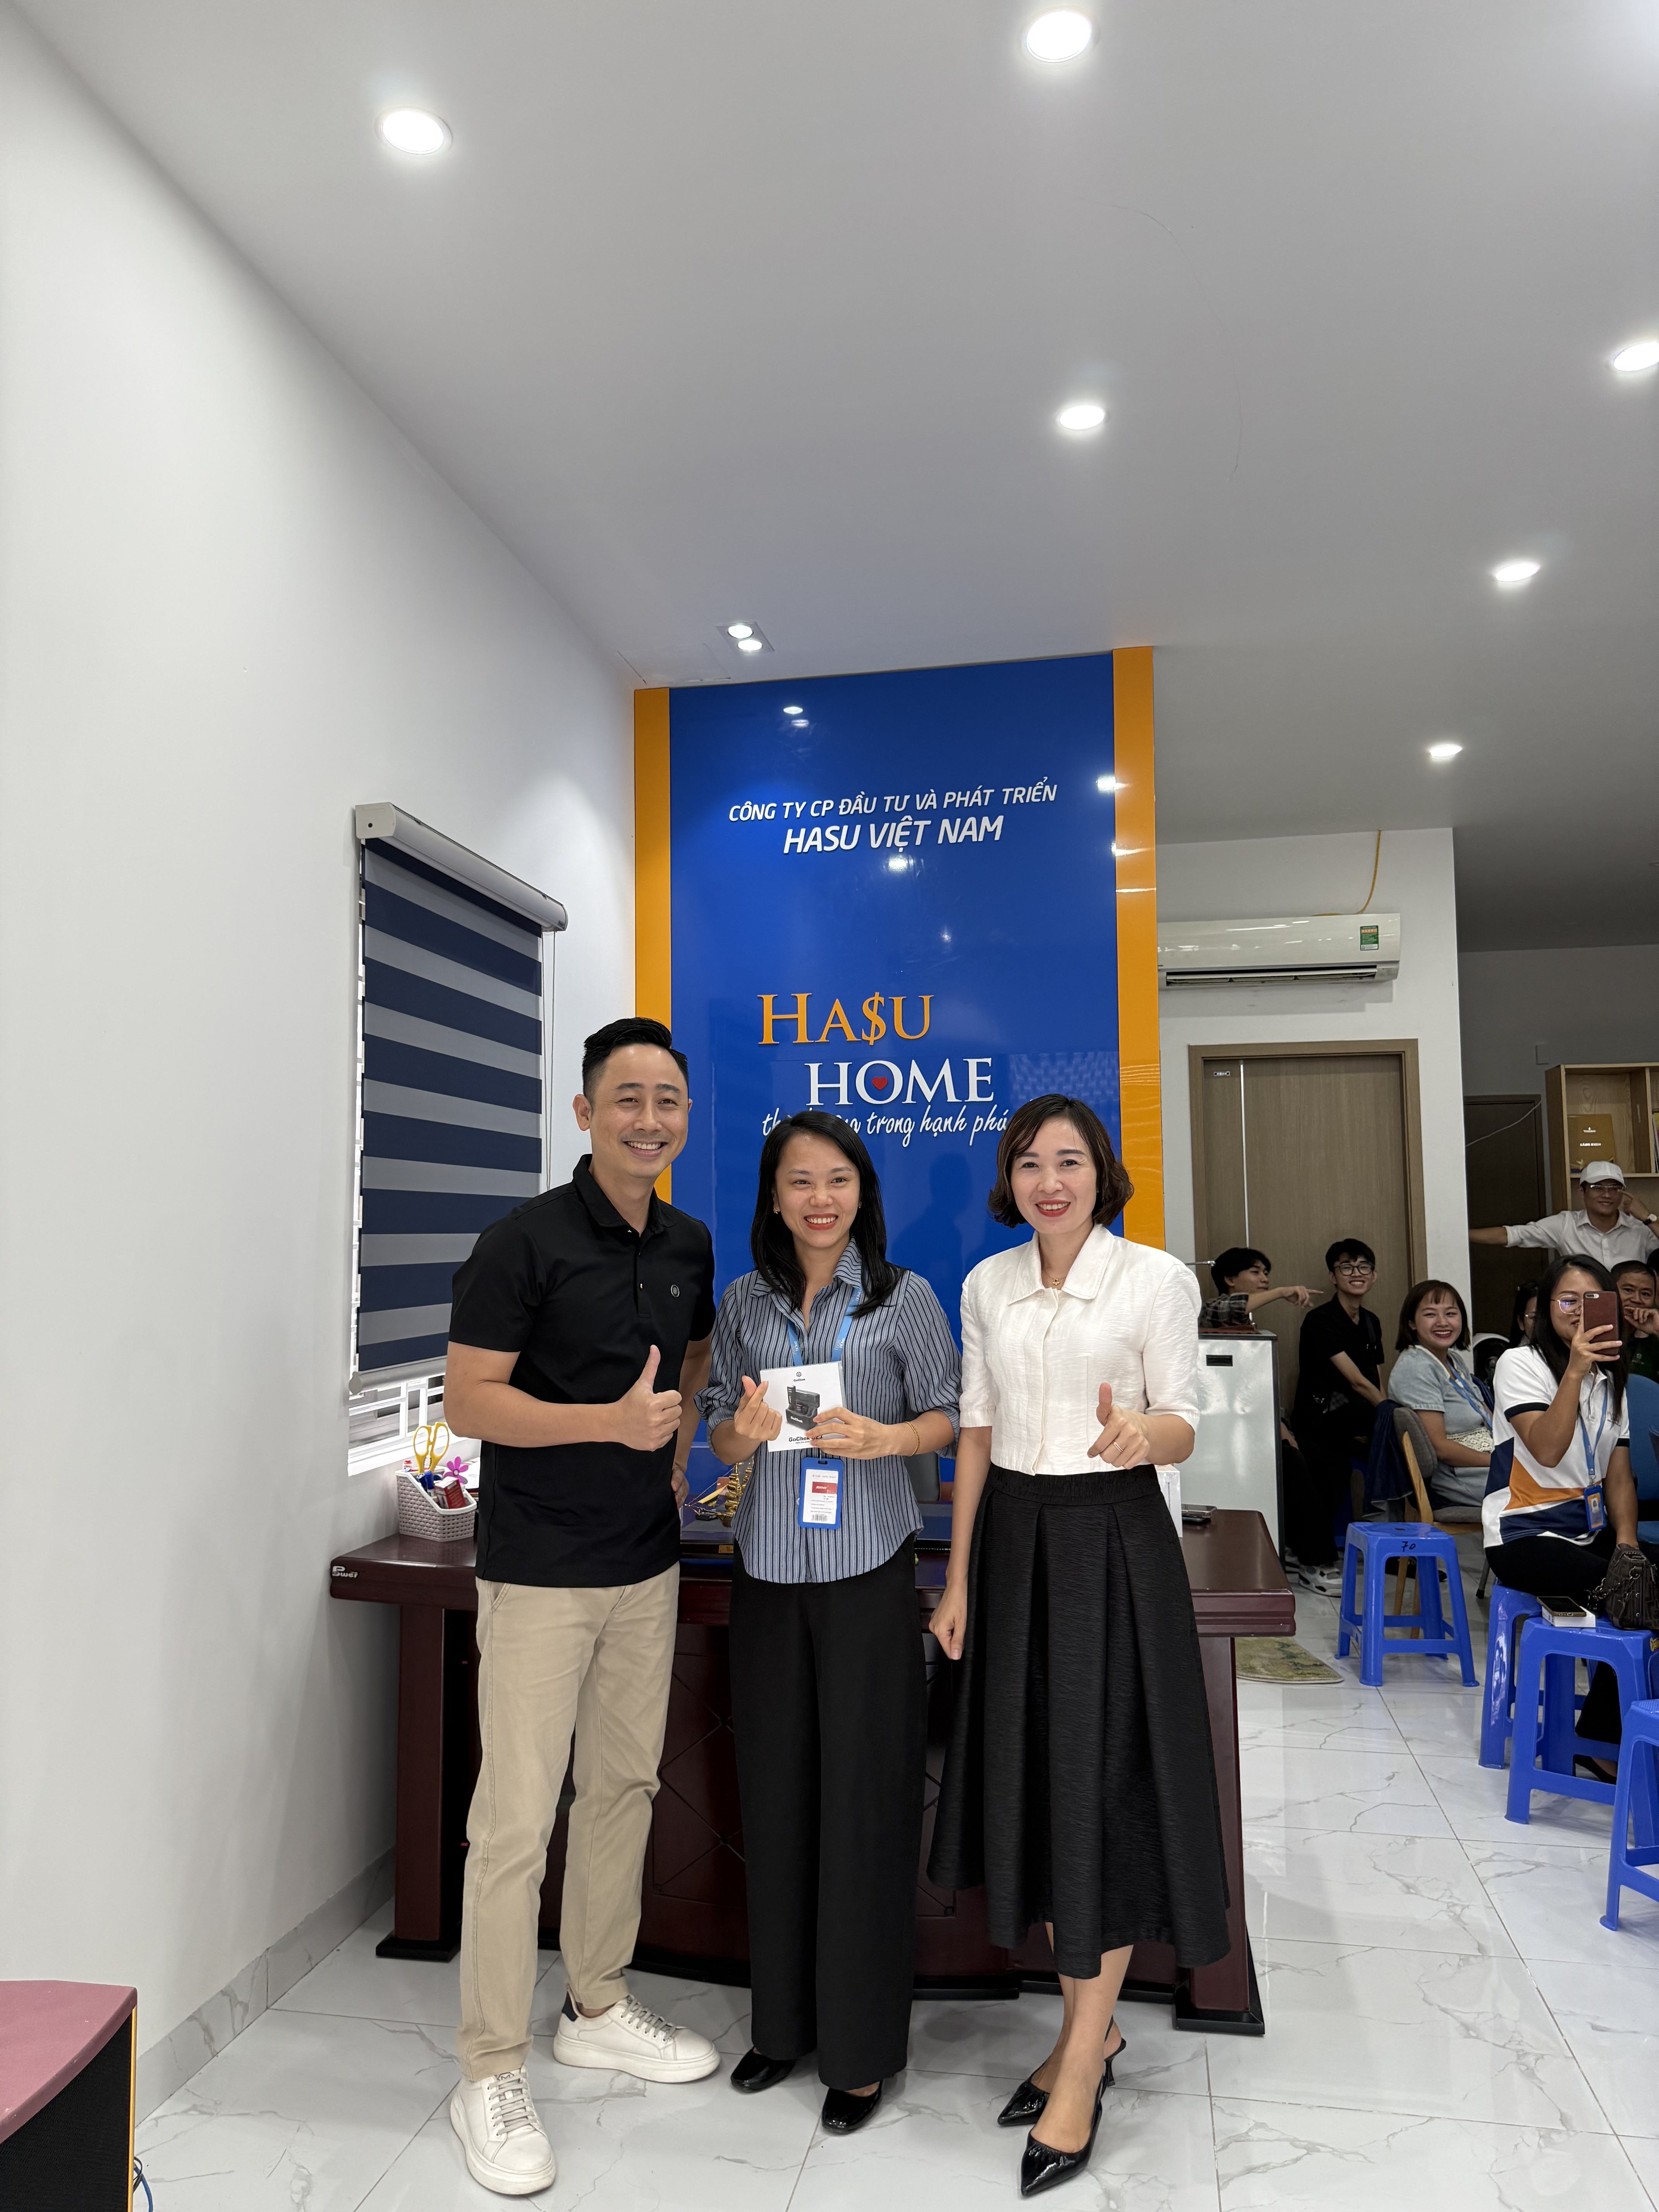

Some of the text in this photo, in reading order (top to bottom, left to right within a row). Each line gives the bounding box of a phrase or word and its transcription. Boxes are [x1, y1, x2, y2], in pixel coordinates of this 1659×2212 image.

[729, 776, 1057, 821] CÔNG TY CP ĐẦU TƯ VÀ PHÁT TRIỂN
[783, 815, 1004, 854] HASU VIỆT NAM
[804, 1058, 994, 1106] HOME
[867, 1112, 915, 1147] trong
[919, 1104, 967, 1137] hạnh
[969, 1104, 1009, 1146] phú
[1401, 1541, 1416, 1552] 70
